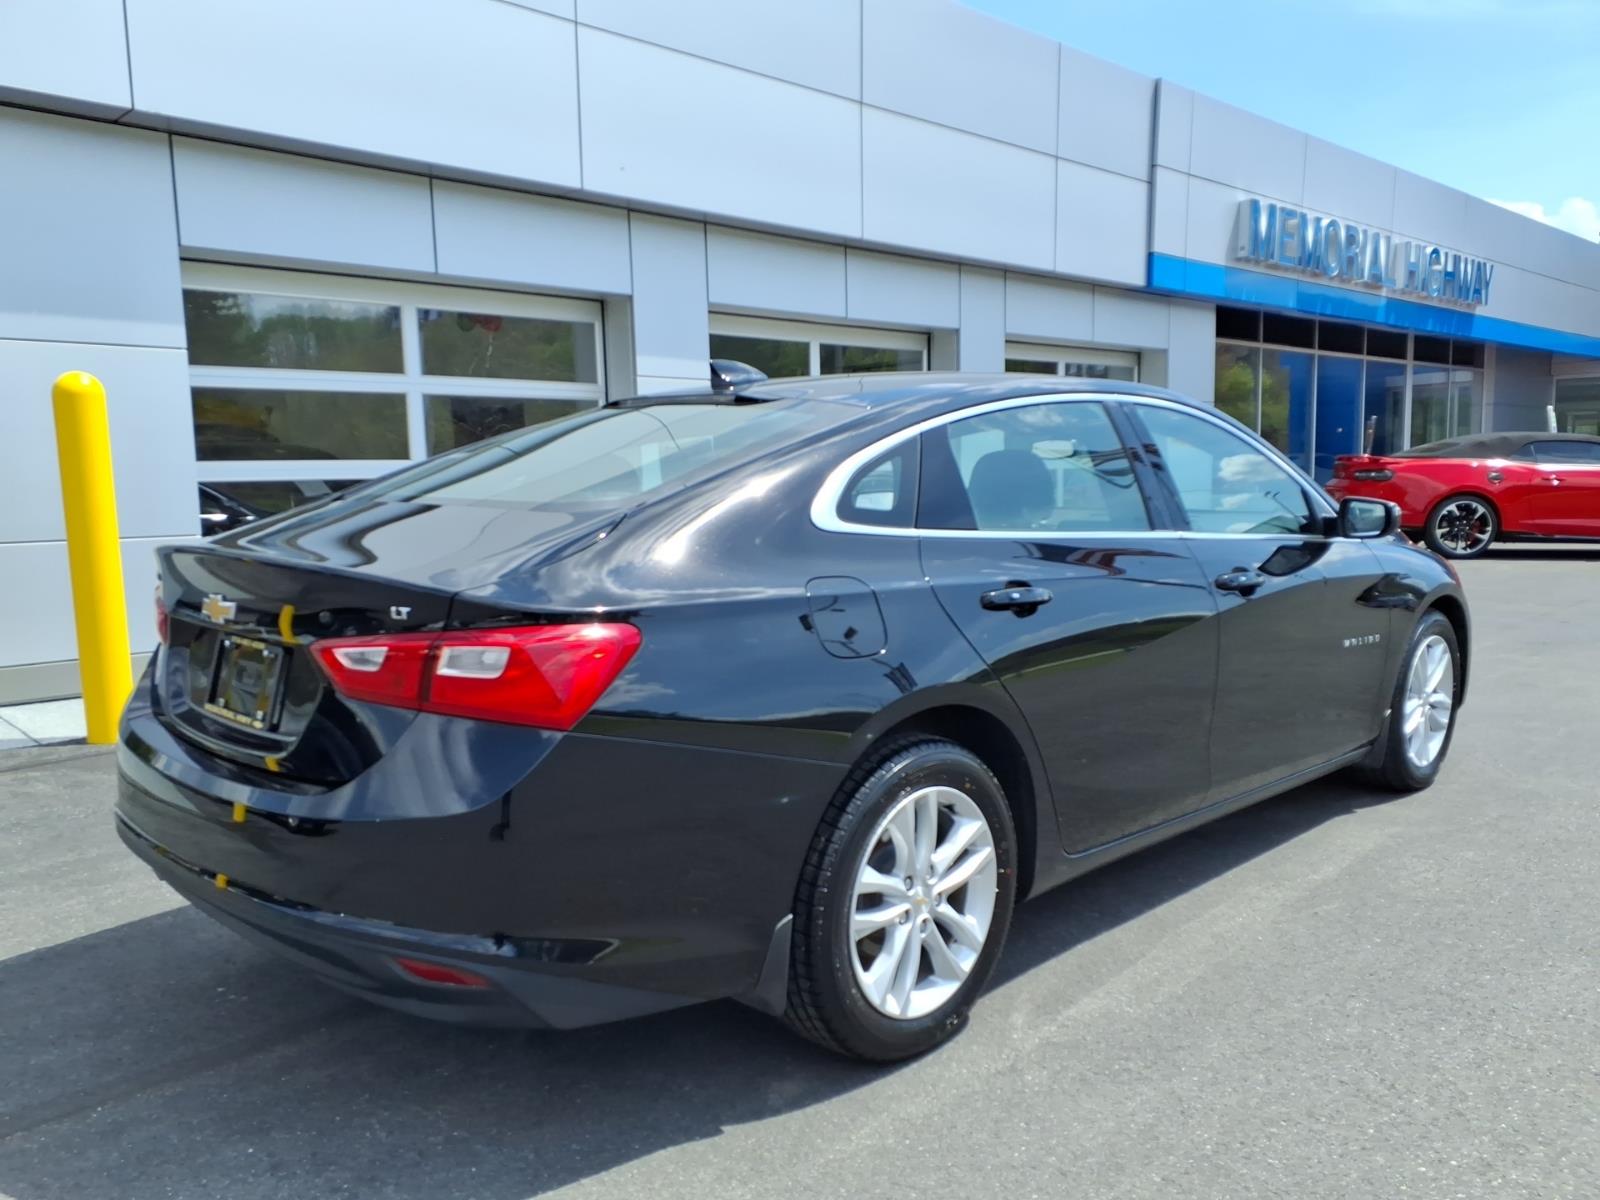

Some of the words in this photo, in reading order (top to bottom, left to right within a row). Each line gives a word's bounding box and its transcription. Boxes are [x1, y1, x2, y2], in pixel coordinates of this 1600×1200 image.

[1248, 198, 1396, 288] MEMORIAL
[1404, 241, 1494, 306] HIGHWAY
[390, 605, 412, 620] LT
